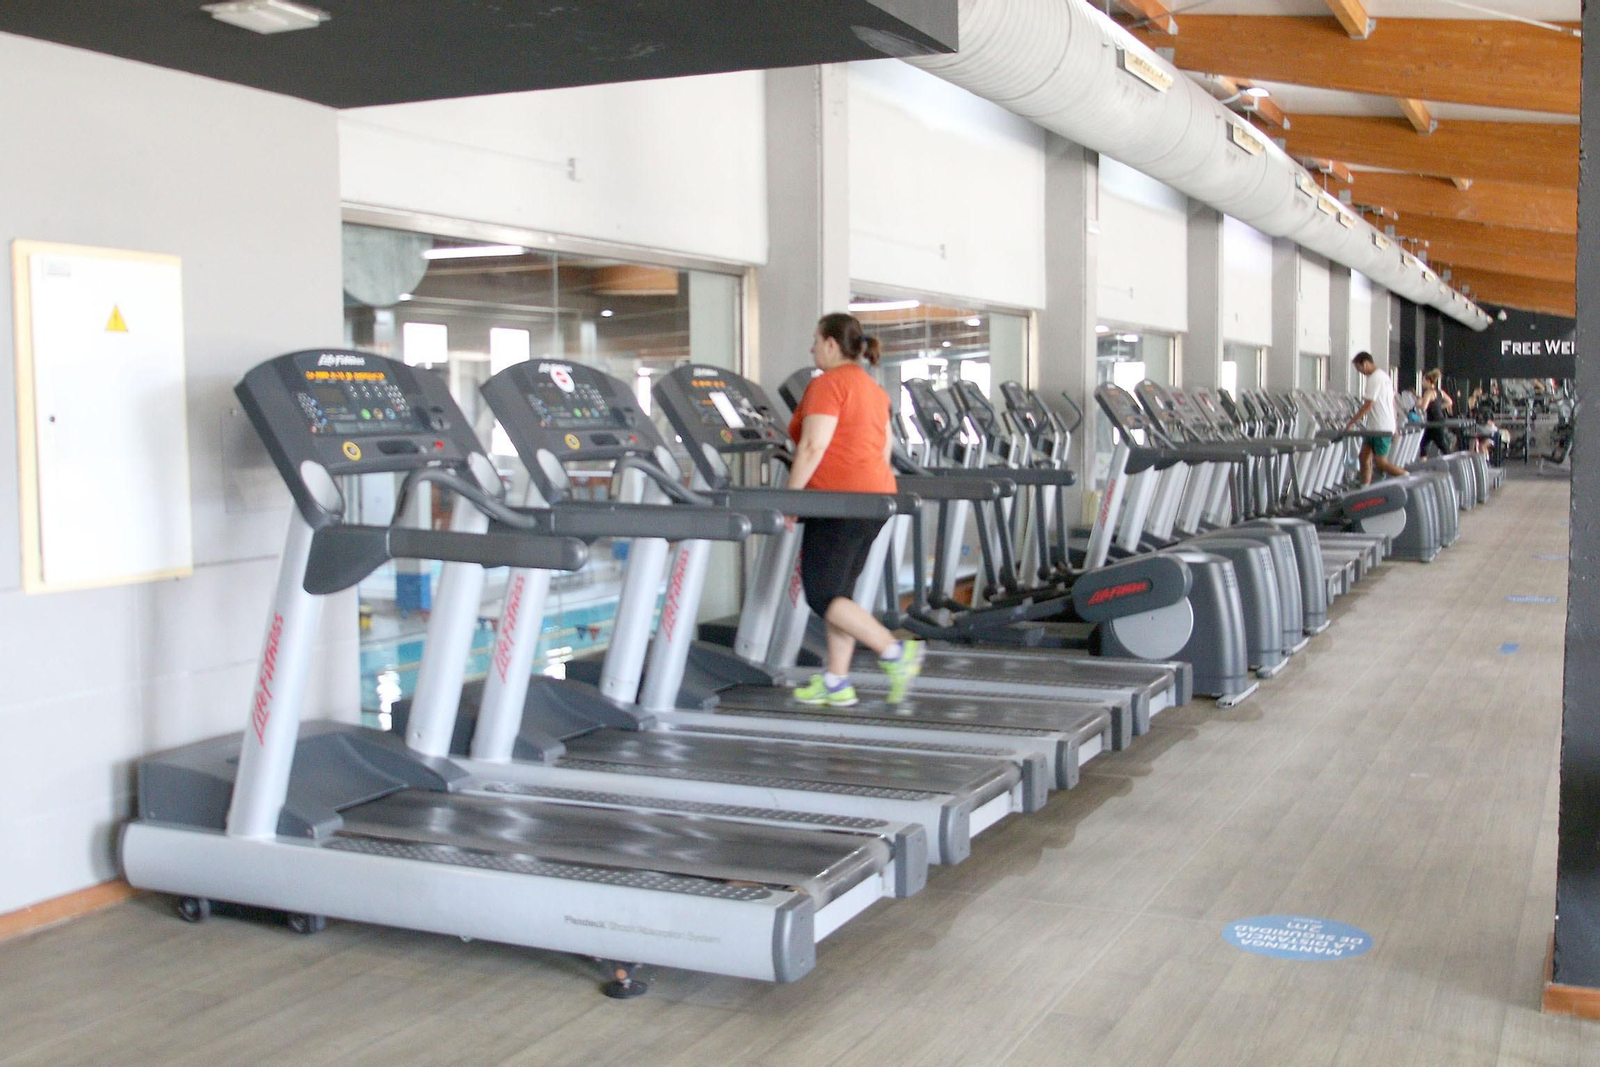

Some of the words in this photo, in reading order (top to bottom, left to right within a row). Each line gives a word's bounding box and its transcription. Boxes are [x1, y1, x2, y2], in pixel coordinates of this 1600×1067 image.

[1501, 339, 1541, 355] FREE
[1234, 925, 1336, 941] SEGURIDAD
[1287, 922, 1323, 933] 2m
[1236, 931, 1328, 949] DISTANCIA
[1240, 938, 1343, 956] MANTENGA
[1334, 941, 1355, 950] LA
[1340, 936, 1363, 945] DE
